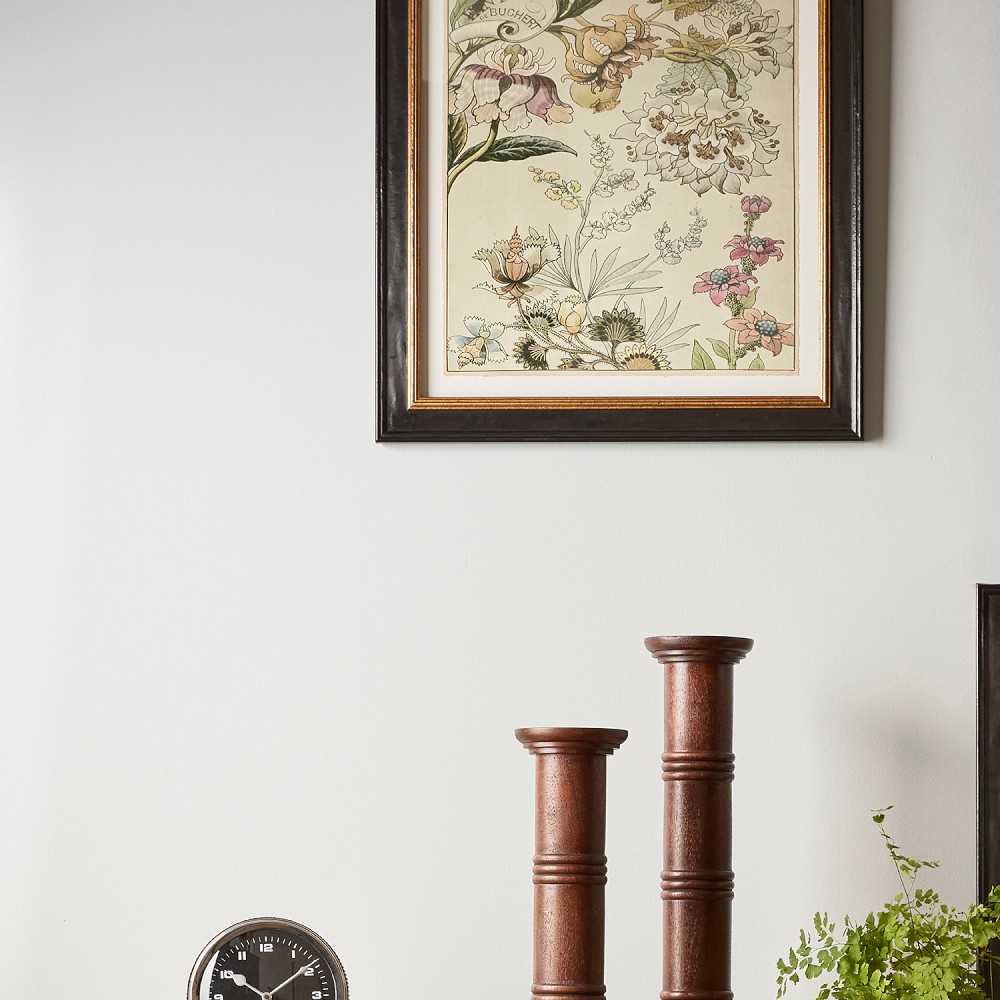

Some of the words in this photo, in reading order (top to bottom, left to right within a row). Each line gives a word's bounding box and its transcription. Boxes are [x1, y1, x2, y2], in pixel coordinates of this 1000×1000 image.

[490, 8, 541, 30] BUCHERT
[260, 943, 273, 952] 12
[238, 951, 246, 960] 11
[291, 950, 296, 958] 1
[220, 970, 234, 979] 10
[304, 967, 314, 976] 2
[311, 991, 322, 999] 3
